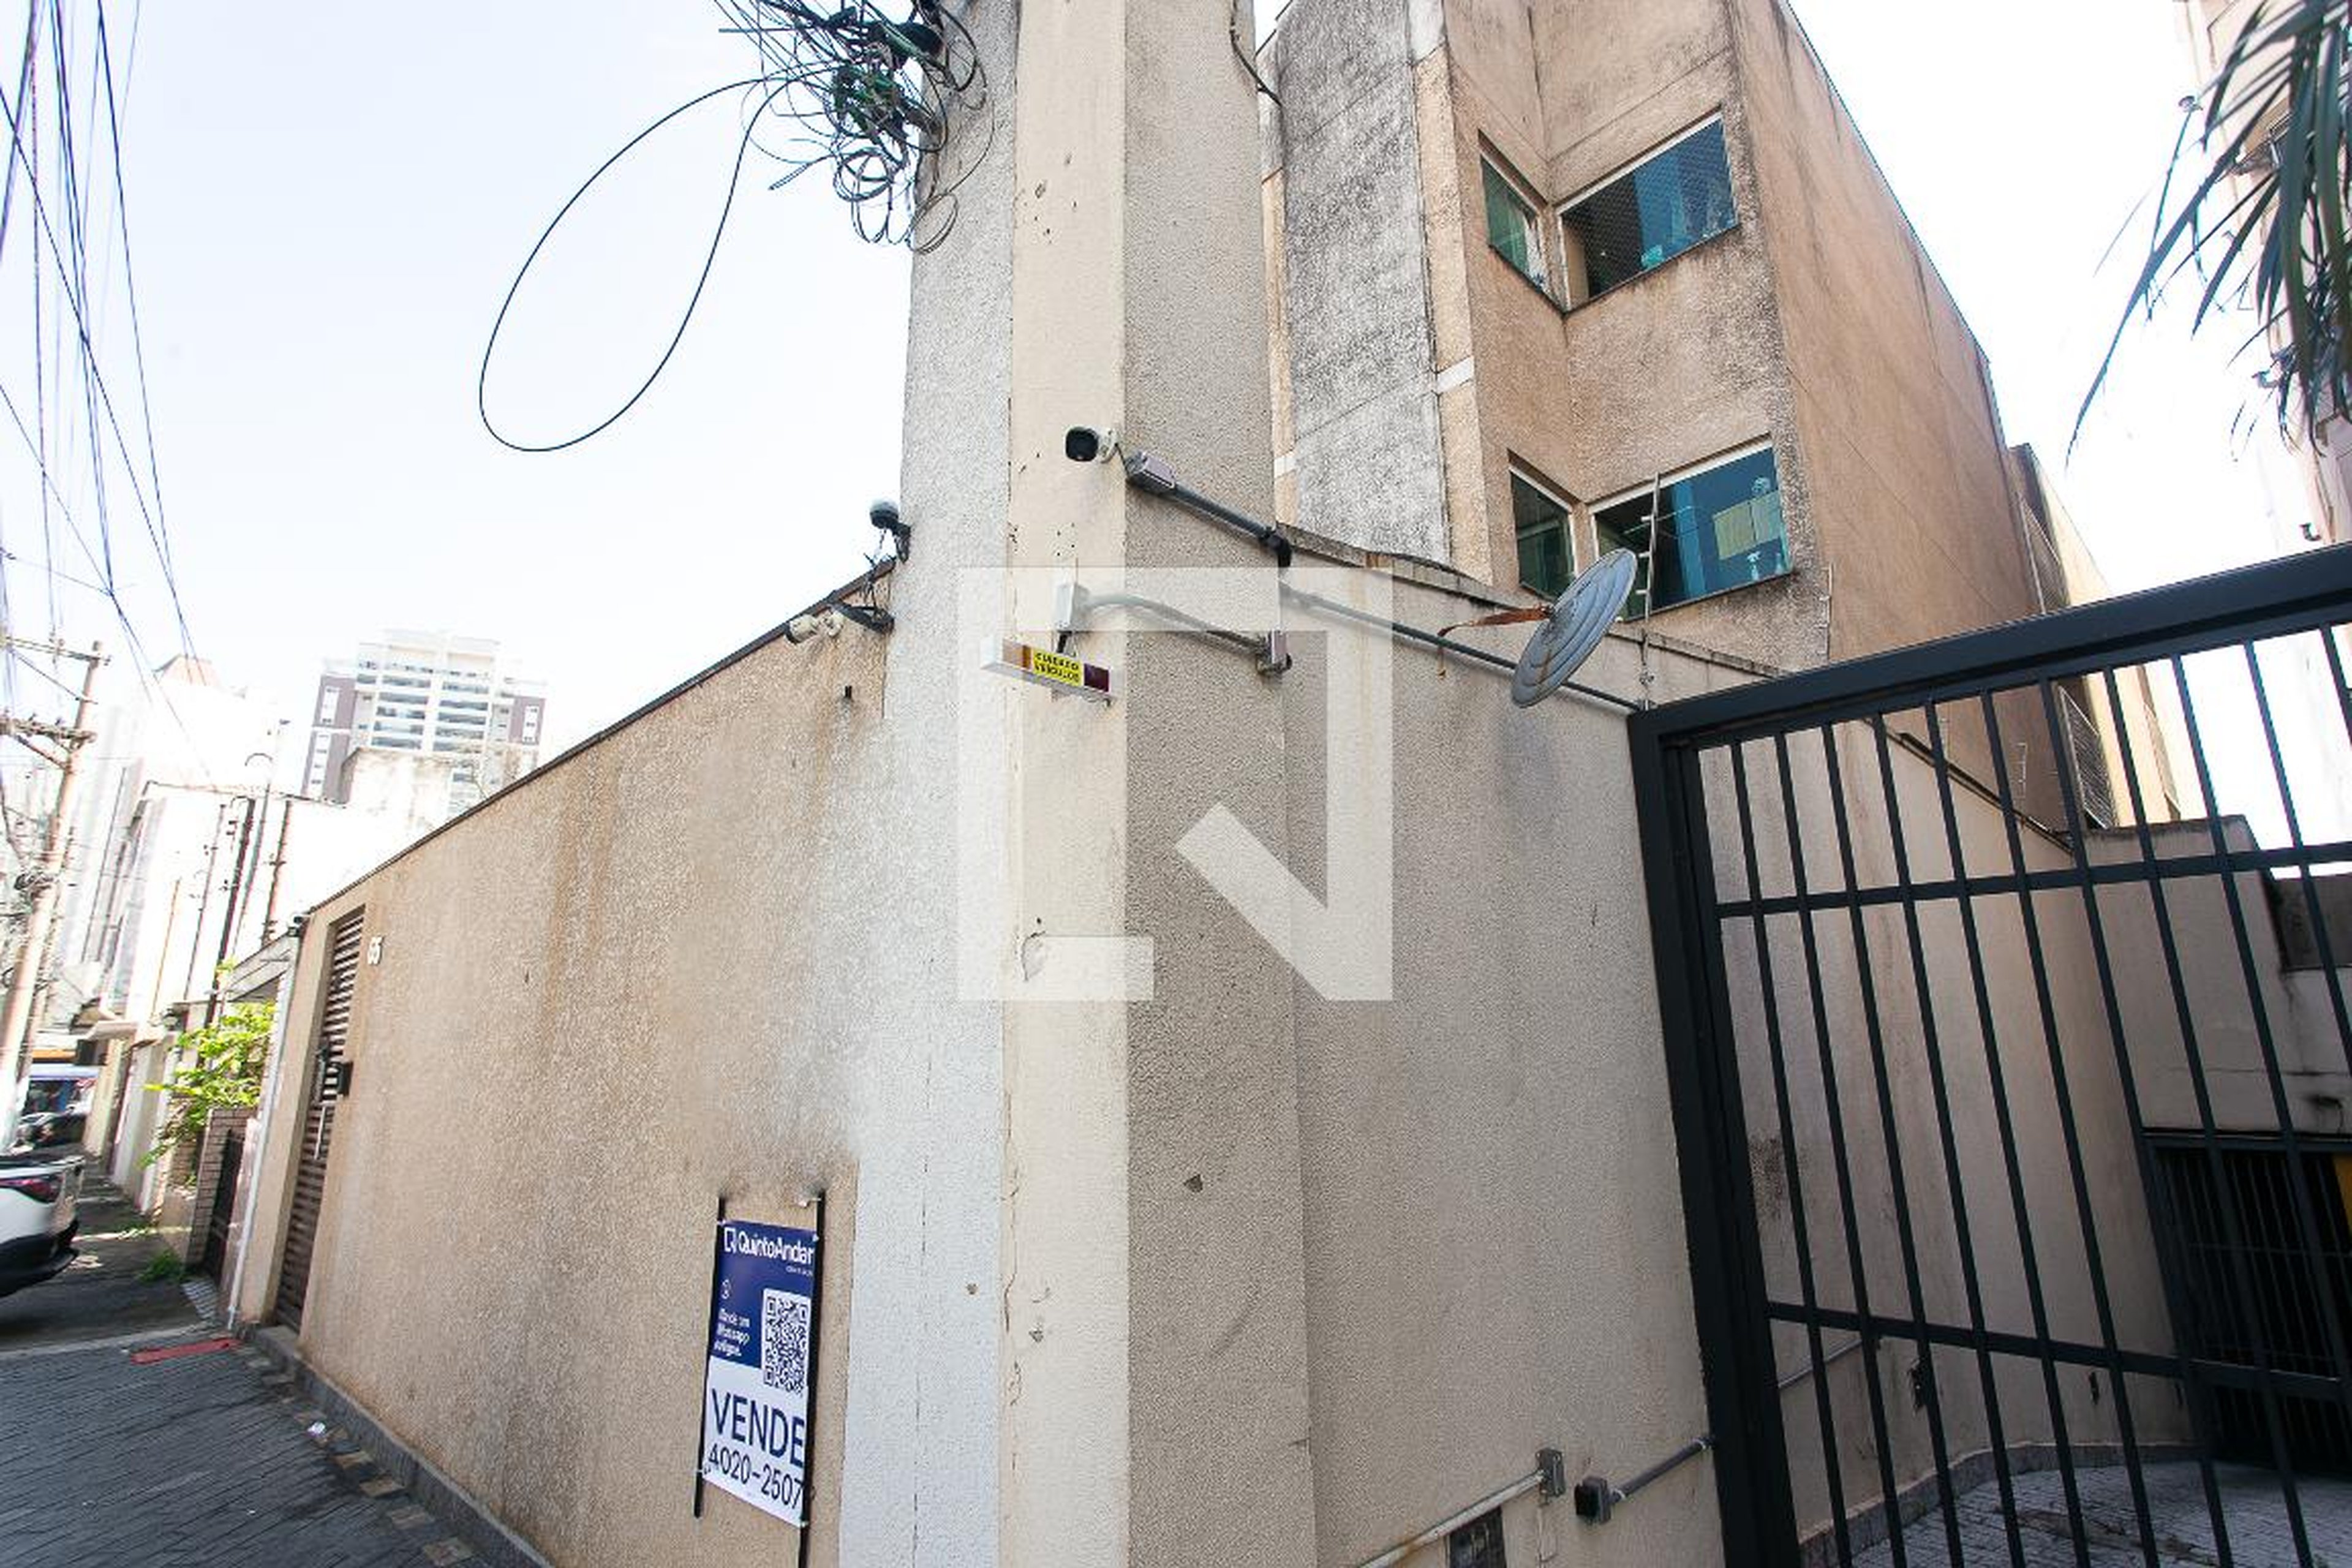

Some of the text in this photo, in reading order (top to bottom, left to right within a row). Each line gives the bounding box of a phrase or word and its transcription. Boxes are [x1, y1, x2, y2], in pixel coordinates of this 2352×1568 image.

[739, 1231, 815, 1265] QuintoAndar
[712, 1388, 805, 1468] VENDE
[708, 1443, 805, 1510] 4020-2507
